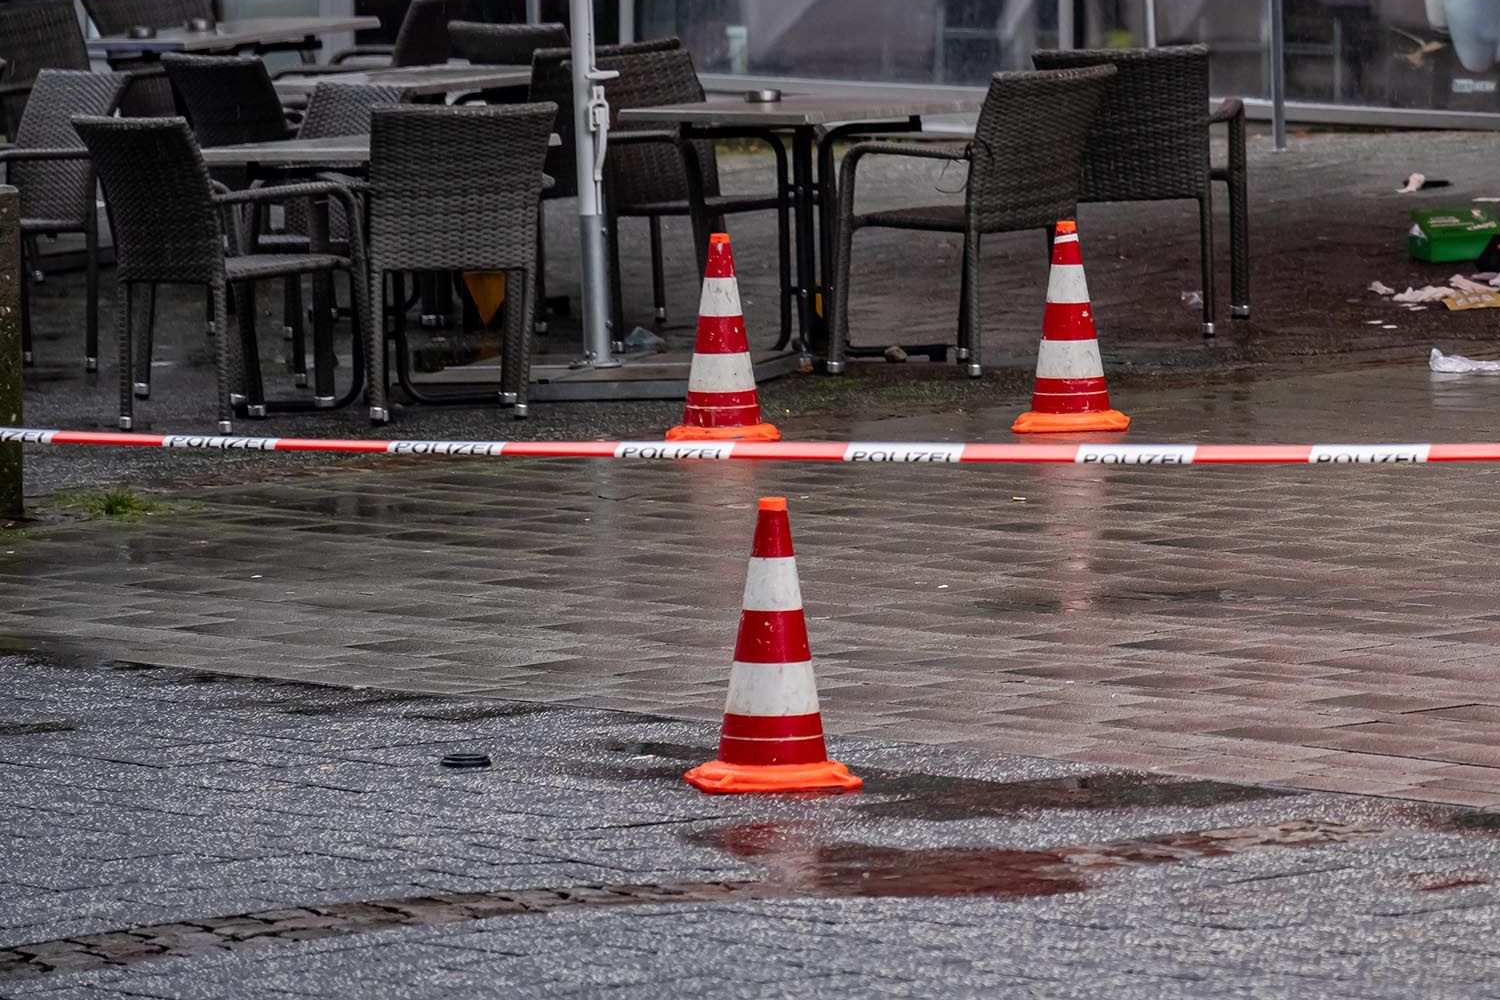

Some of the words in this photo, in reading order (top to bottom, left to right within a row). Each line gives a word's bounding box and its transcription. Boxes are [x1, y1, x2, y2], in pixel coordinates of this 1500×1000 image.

[169, 436, 268, 450] POLIZEI
[394, 442, 494, 455] POLIZEI
[621, 447, 722, 459] POLIZEI
[850, 450, 952, 462] POLIZEI
[1083, 453, 1184, 464] POLIZEI
